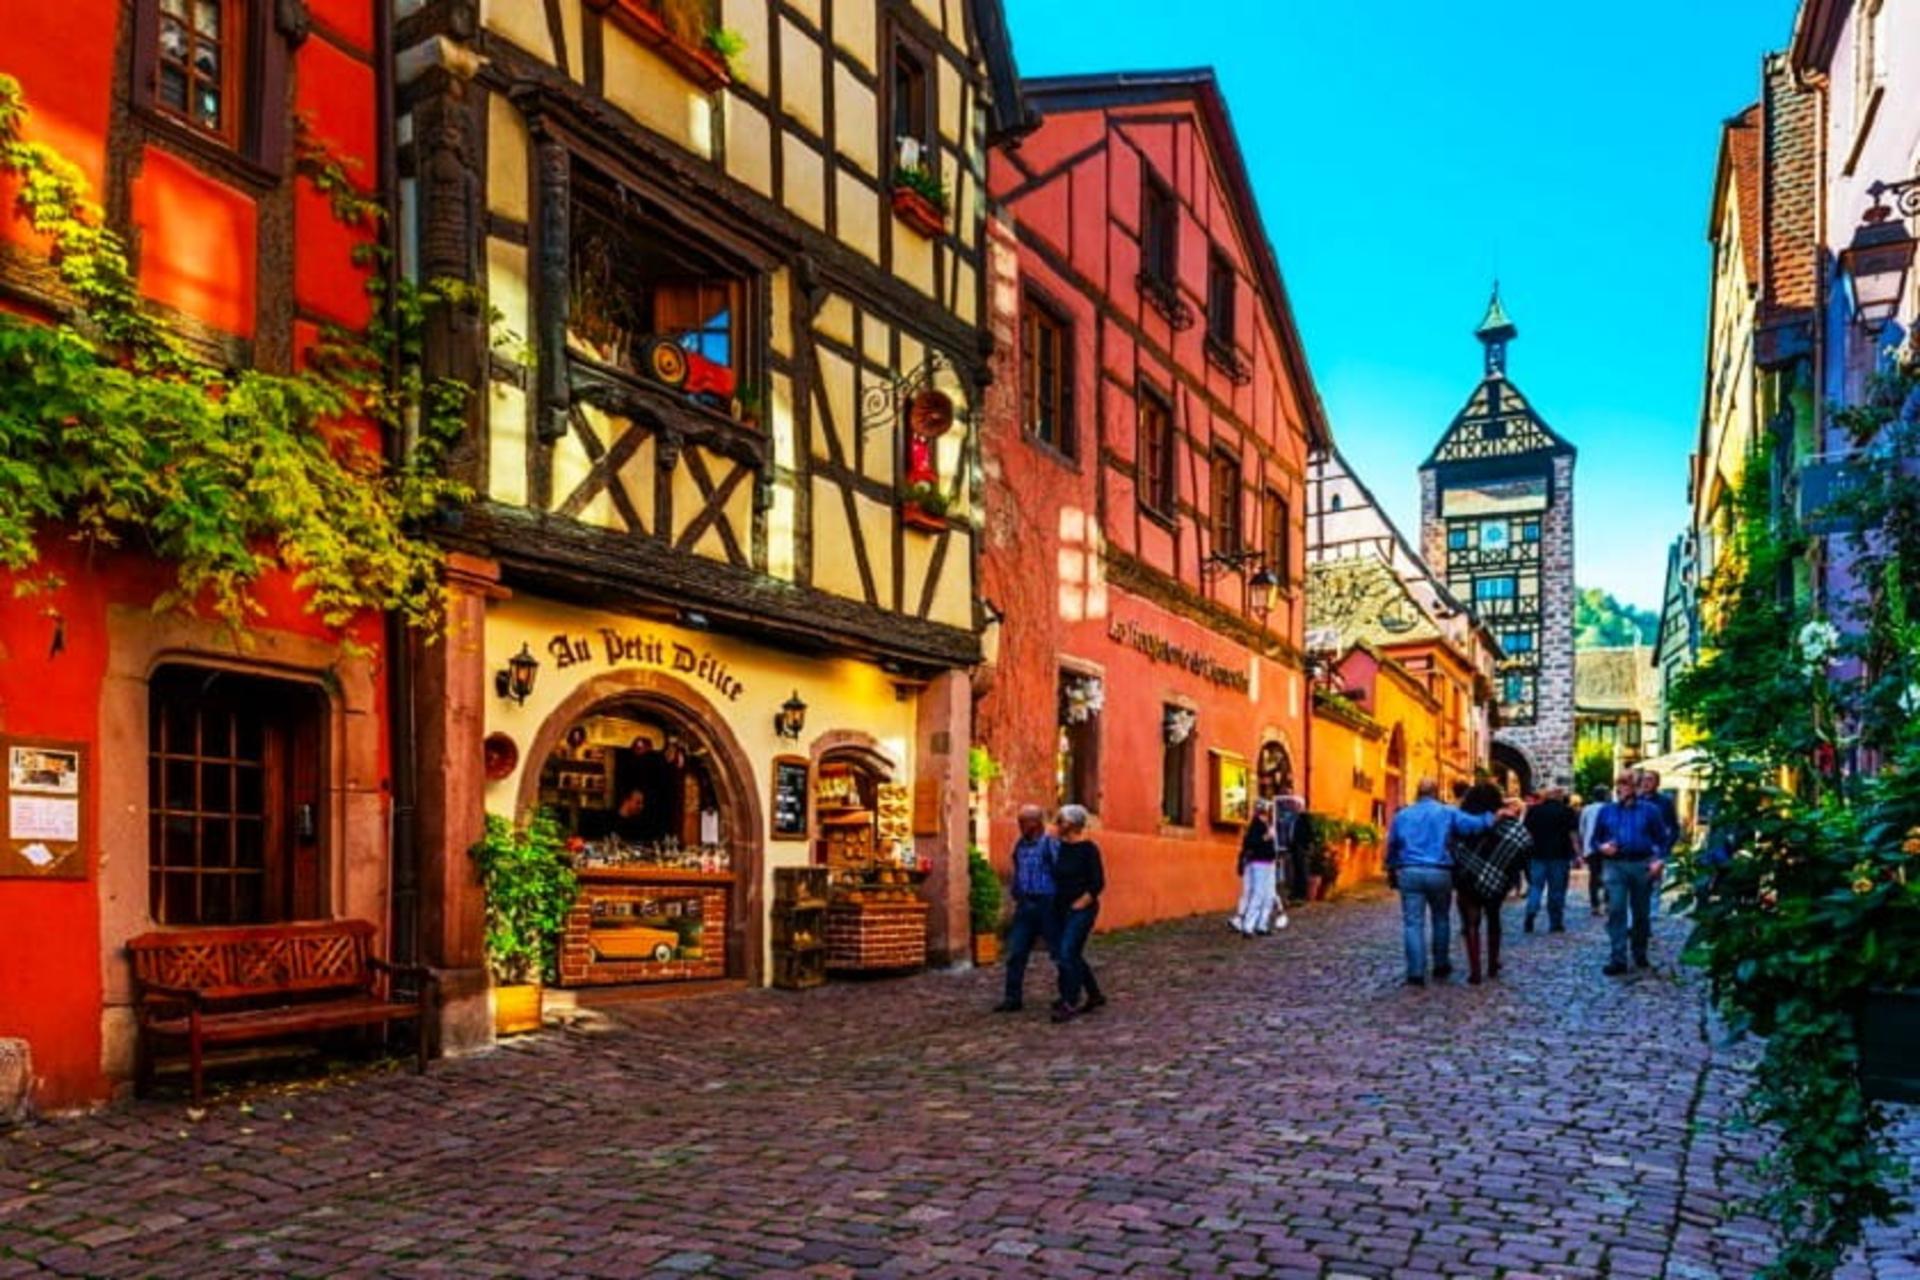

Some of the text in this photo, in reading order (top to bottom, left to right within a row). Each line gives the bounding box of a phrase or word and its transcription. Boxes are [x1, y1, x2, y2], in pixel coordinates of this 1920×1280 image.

[548, 628, 744, 701] Au Petit Délice
